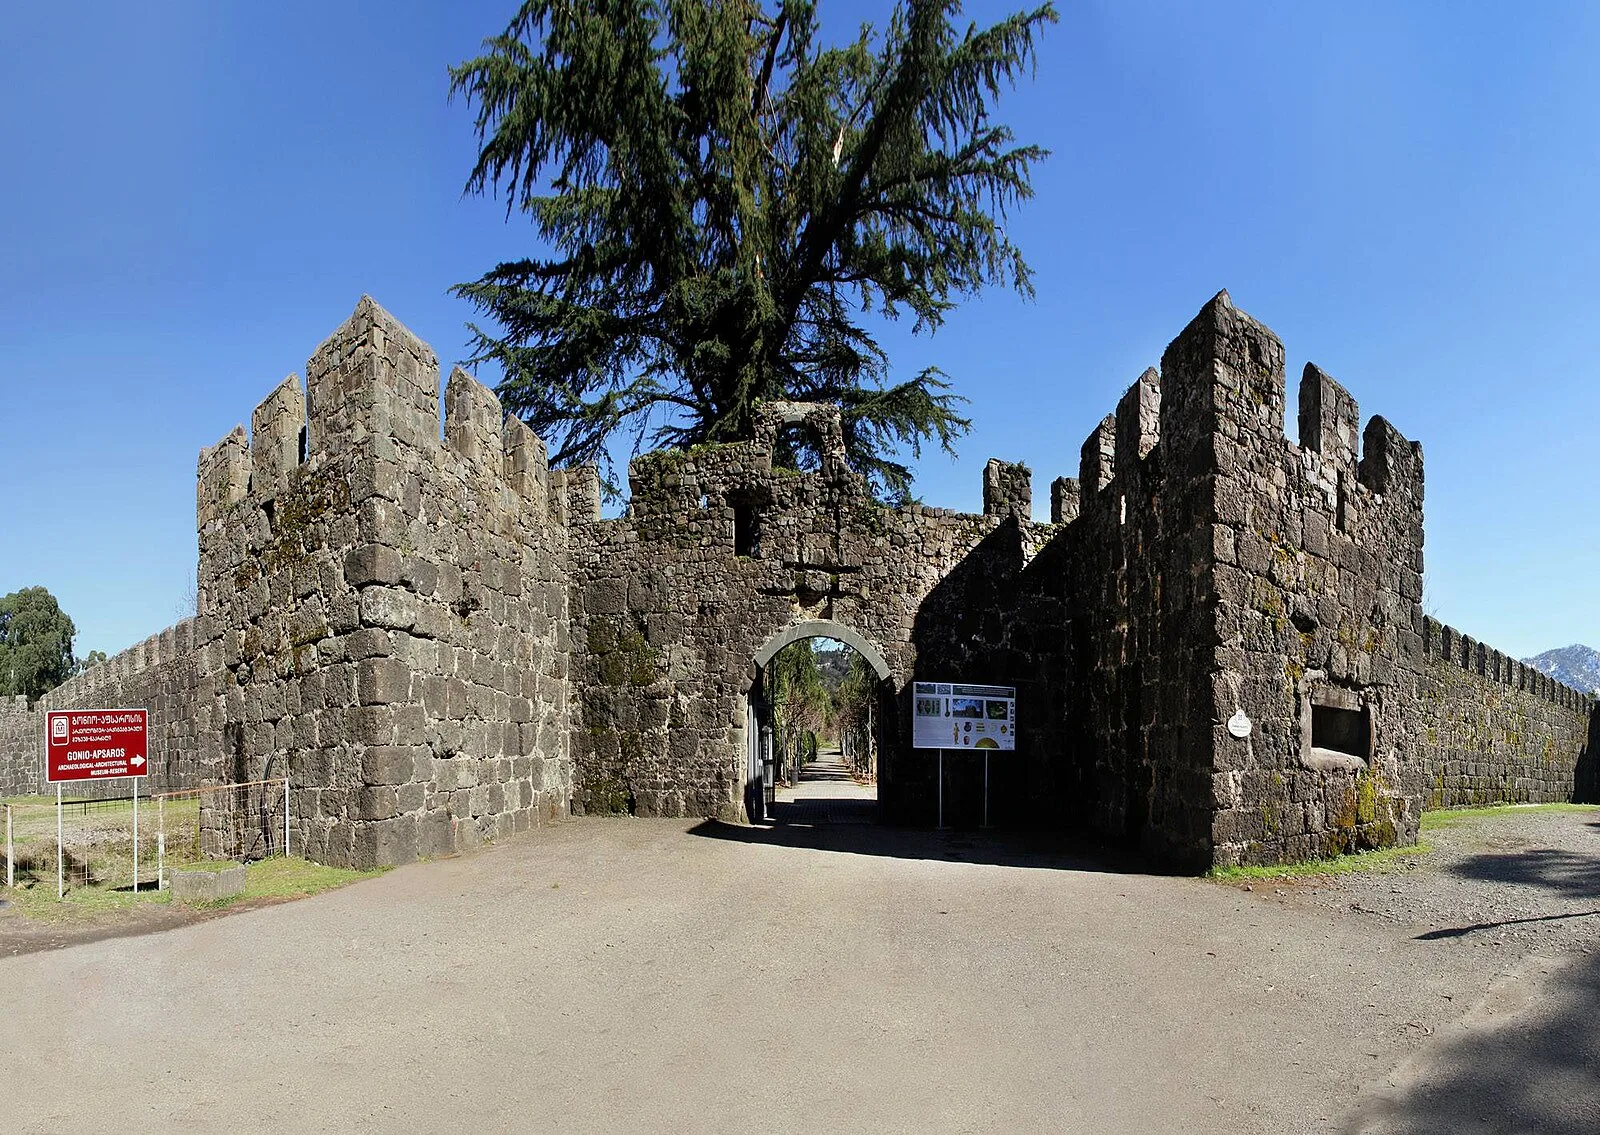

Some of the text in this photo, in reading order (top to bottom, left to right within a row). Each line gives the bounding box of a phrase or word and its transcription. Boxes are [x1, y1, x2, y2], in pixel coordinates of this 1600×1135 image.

[67, 748, 125, 761] GONIO-APSAROS
[58, 760, 128, 771] ARCHAEOLOGICAL-ARCHITECTURAL
[90, 767, 128, 776] MUSEUM-RESERVE
